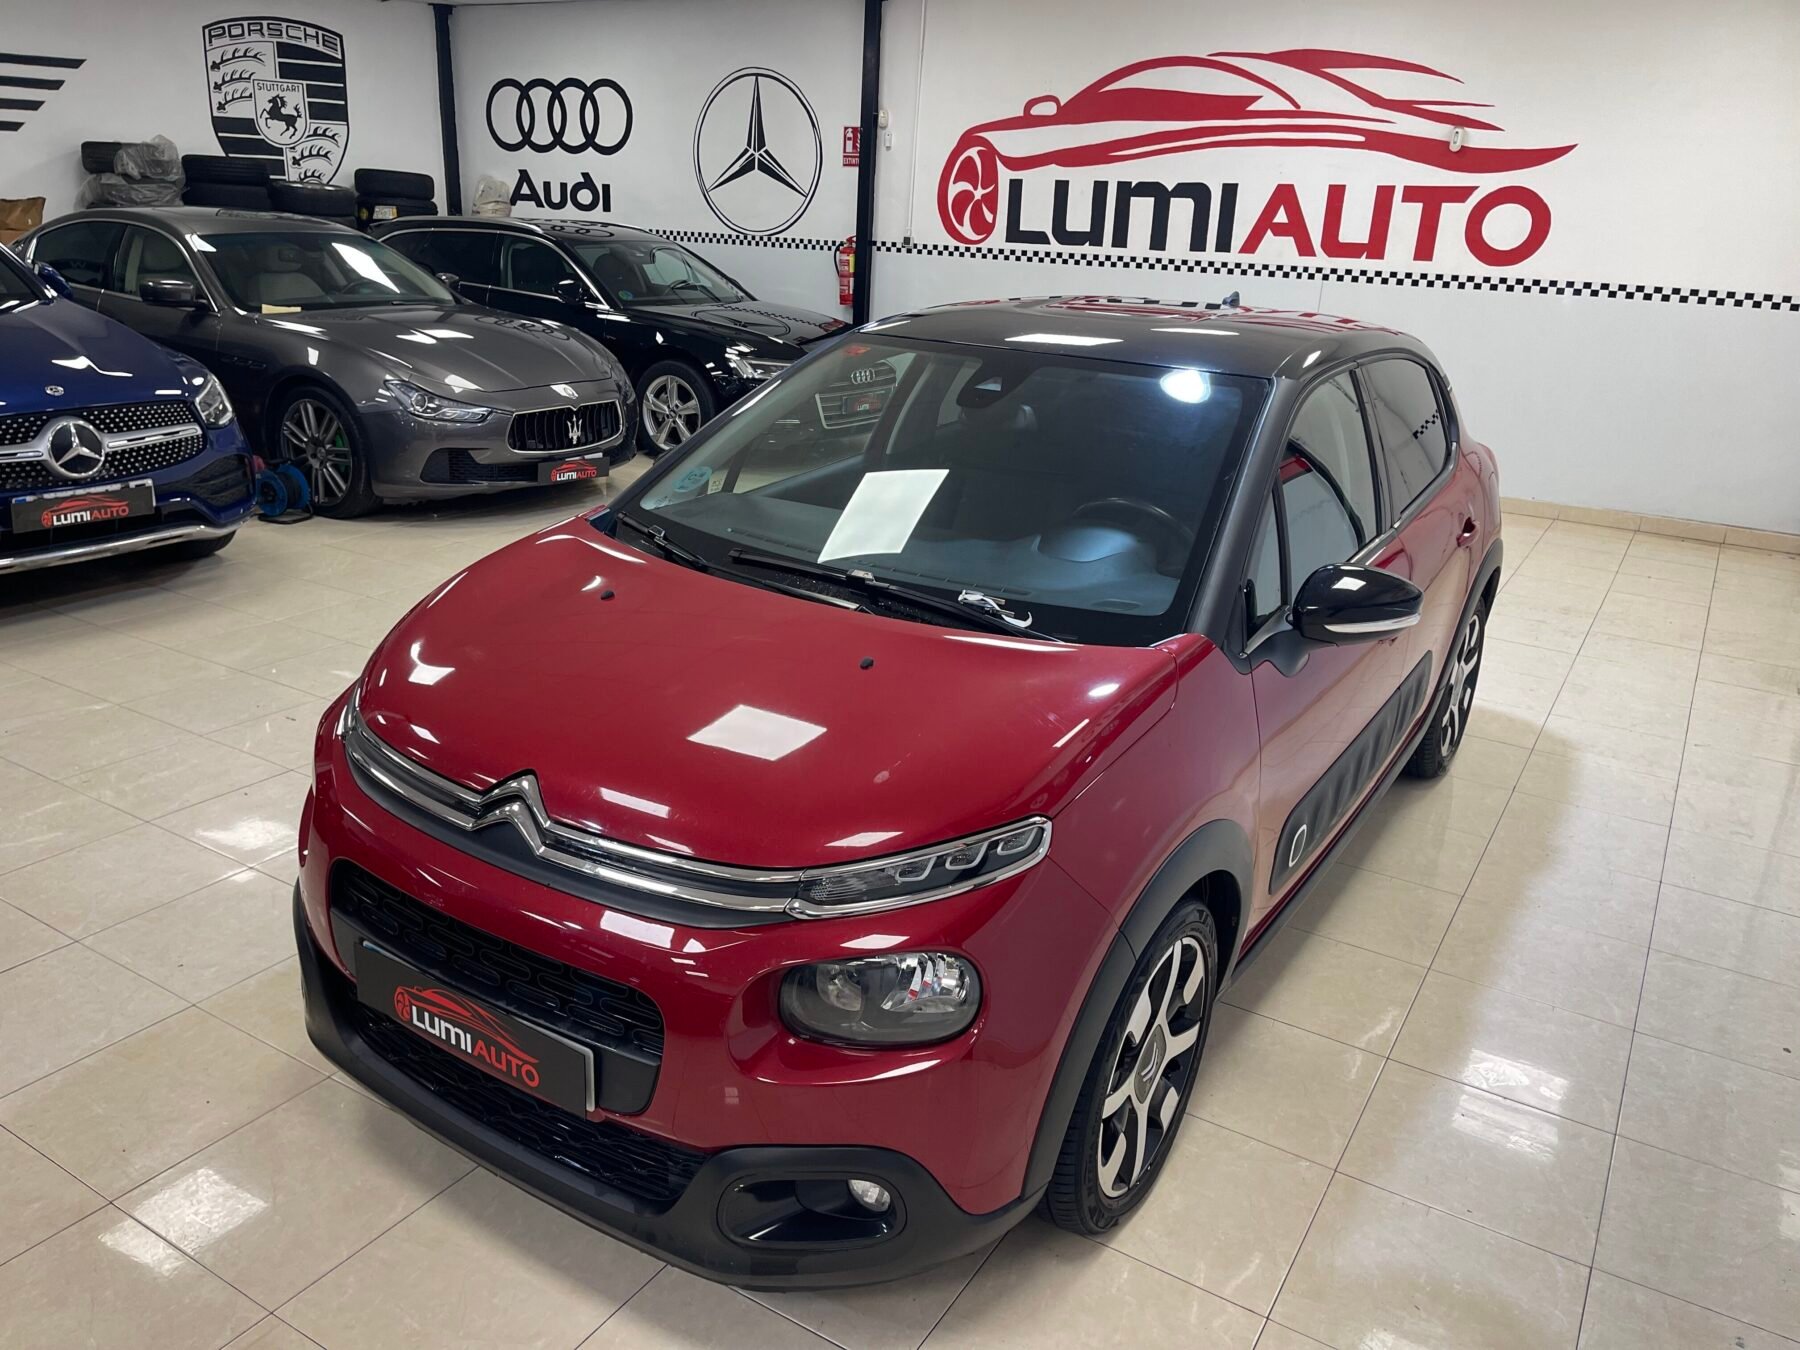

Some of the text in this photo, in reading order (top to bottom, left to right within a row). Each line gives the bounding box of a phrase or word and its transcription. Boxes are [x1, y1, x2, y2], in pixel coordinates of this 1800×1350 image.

[208, 22, 340, 56] PORSCHE
[256, 82, 300, 93] STUTTGART
[843, 156, 860, 166] EXTINT
[510, 169, 611, 212] Audi
[412, 1005, 539, 1088] LUMIAUTO
